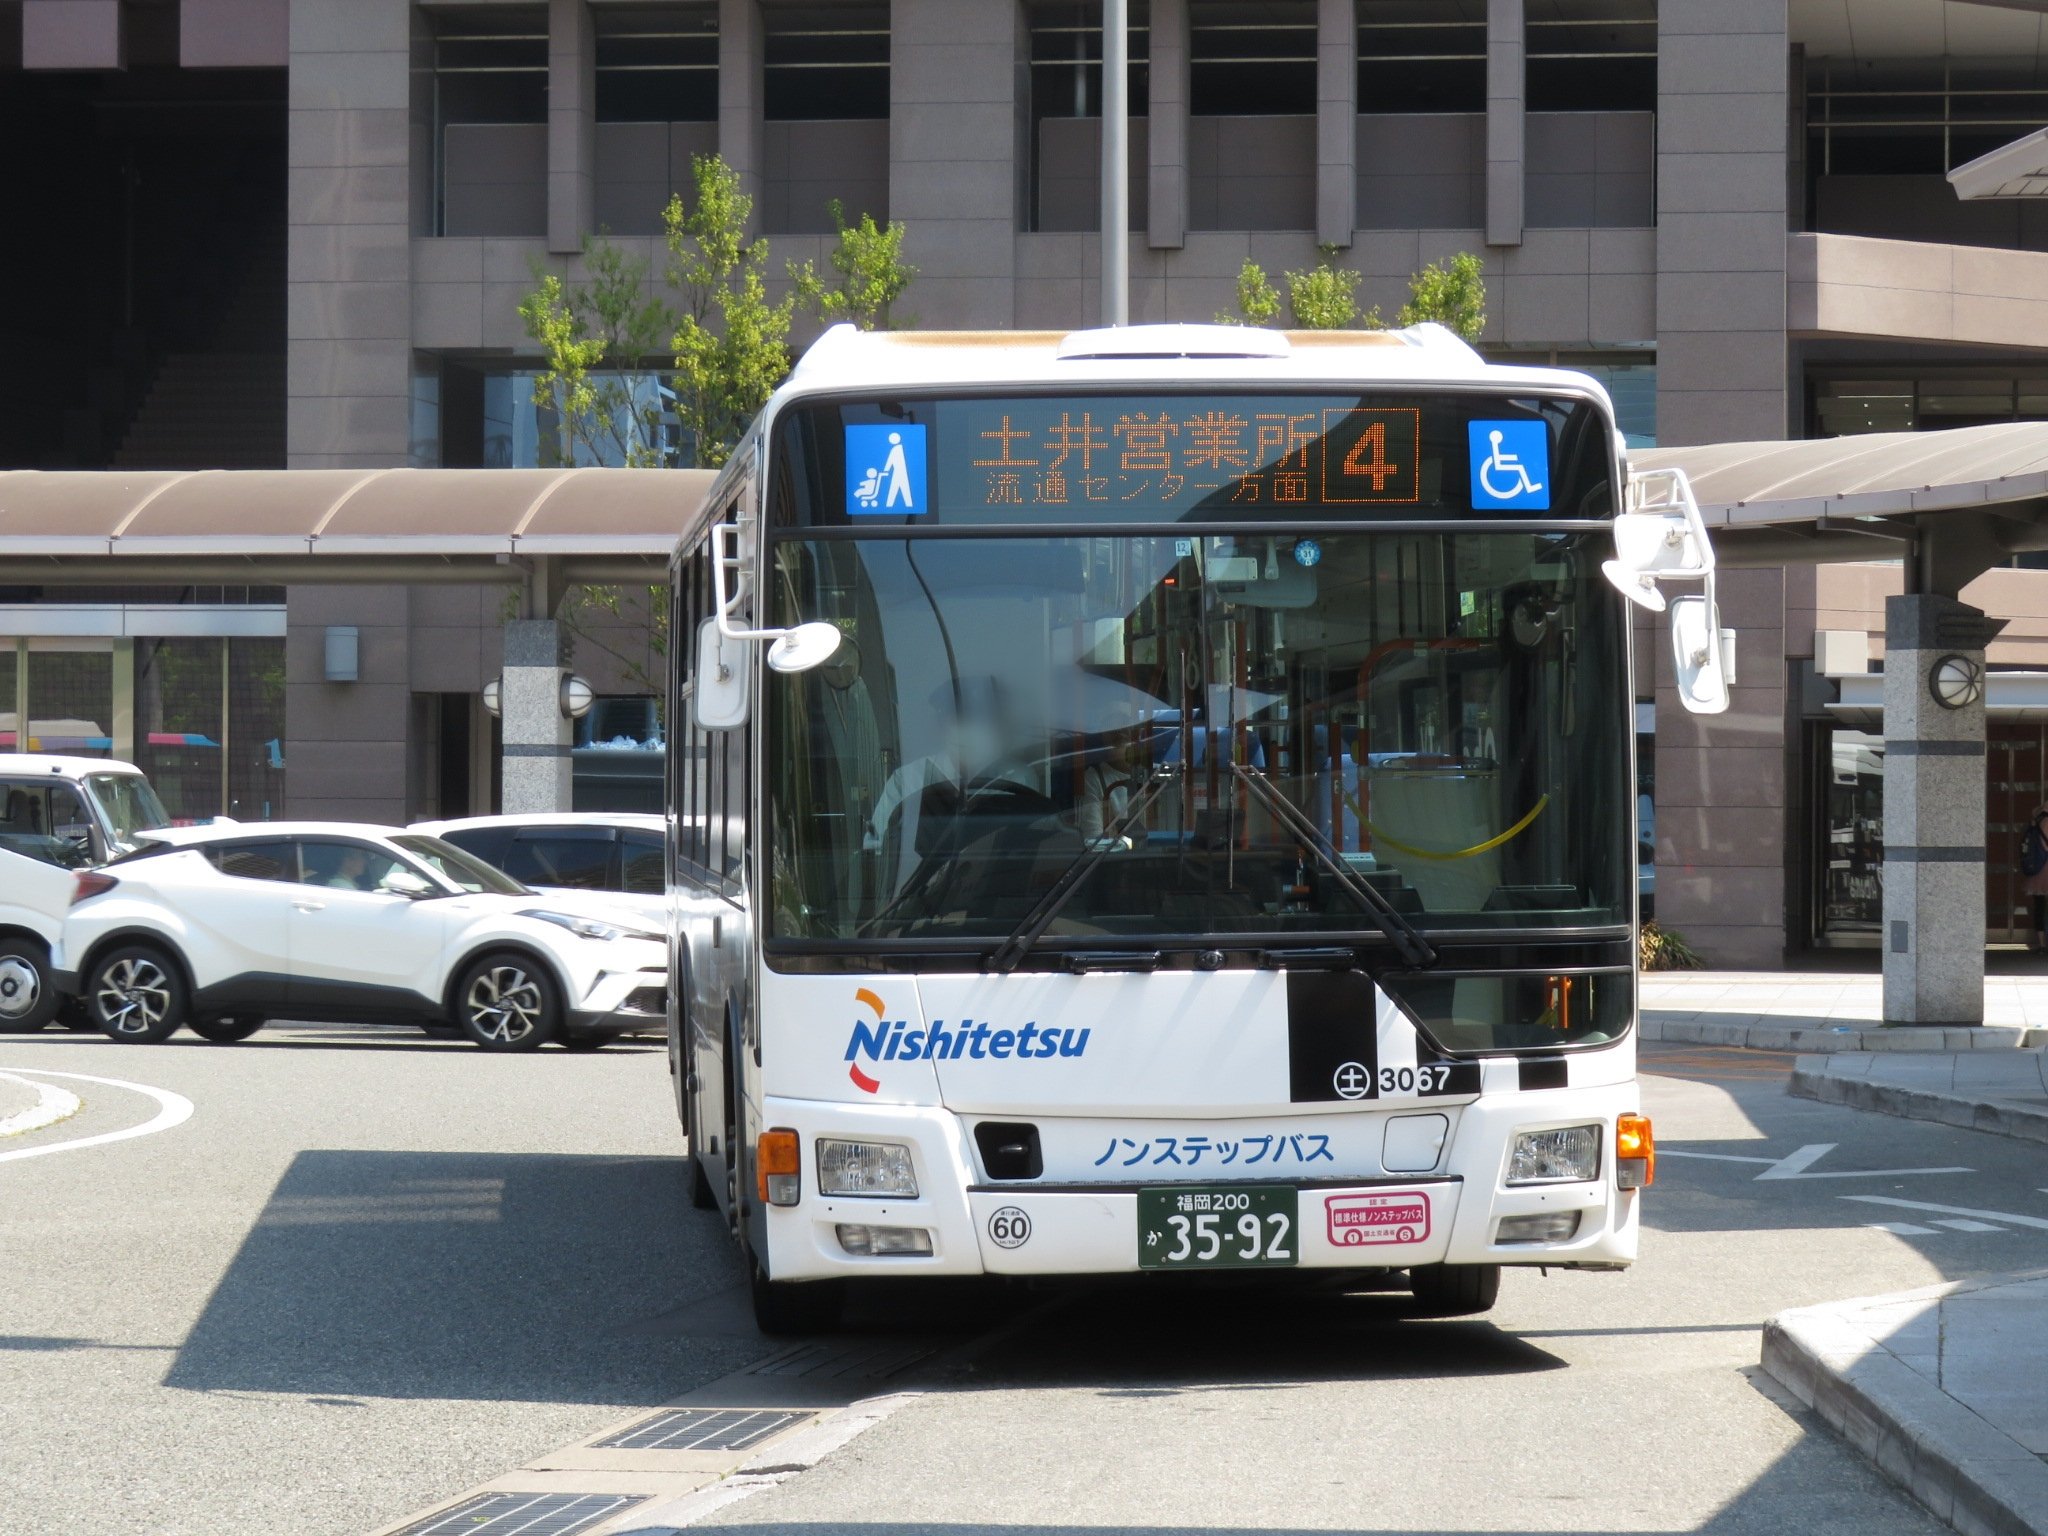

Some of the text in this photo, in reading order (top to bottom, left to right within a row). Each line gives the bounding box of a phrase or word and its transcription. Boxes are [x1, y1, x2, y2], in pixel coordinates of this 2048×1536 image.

[973, 411, 1318, 470] 土井営業所
[1343, 422, 1398, 491] 4
[987, 471, 1308, 503] 流通センター方面
[844, 1019, 1091, 1062] Nishitetsu
[1380, 1066, 1451, 1092] 3067
[1094, 1134, 1334, 1167] ノンステップバス
[993, 1216, 1027, 1239] 60
[1146, 1213, 1291, 1261] か 35-92
